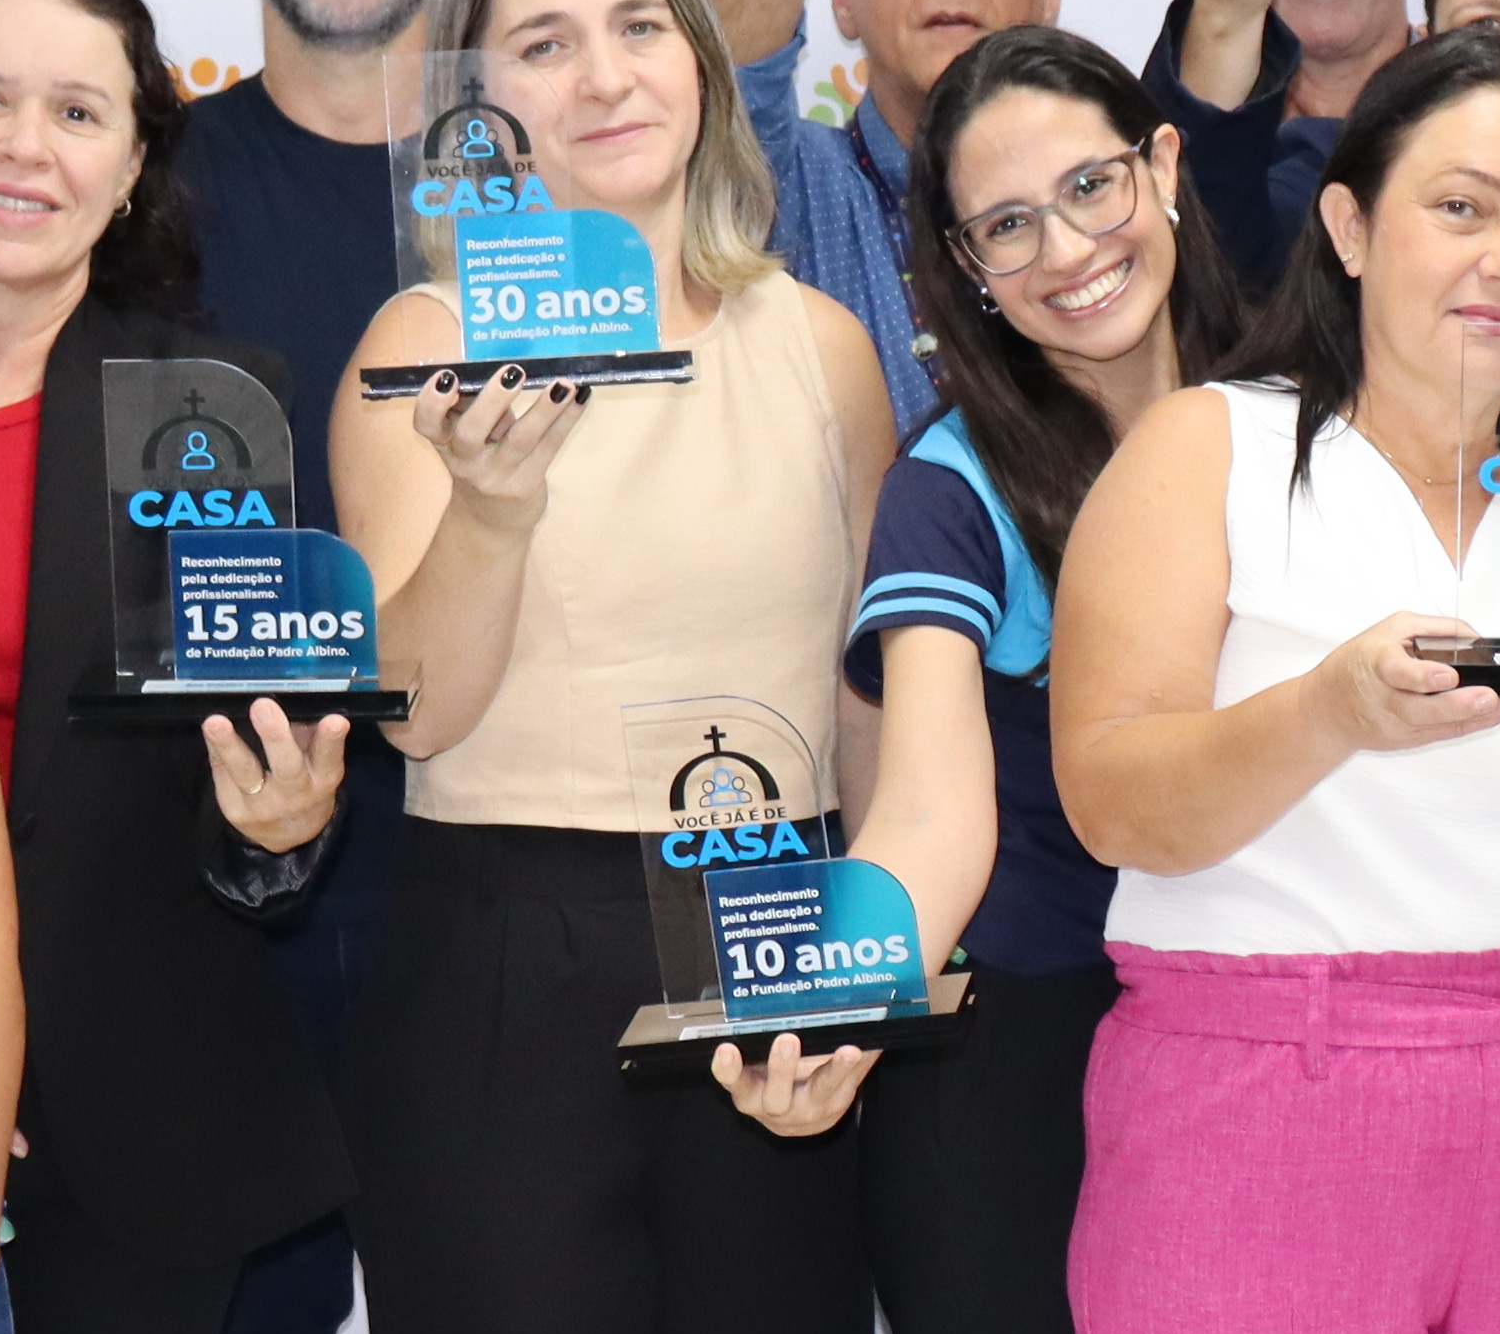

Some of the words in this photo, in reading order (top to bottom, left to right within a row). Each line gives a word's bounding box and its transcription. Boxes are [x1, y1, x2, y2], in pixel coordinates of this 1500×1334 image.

[411, 175, 554, 217] CASA
[469, 284, 527, 324] 30
[536, 284, 646, 319] anos
[128, 490, 276, 528] CASA
[181, 556, 282, 568] Reconhecimento
[181, 573, 208, 587] pela
[210, 572, 272, 587] dedicação
[275, 575, 283, 584] e
[182, 589, 279, 602] profissionalismo.
[185, 604, 240, 641] 15
[251, 609, 365, 641] anos
[186, 647, 201, 658] de
[204, 646, 265, 660] Fundação
[268, 646, 304, 658] Padre
[306, 645, 350, 658] Albino.
[674, 811, 720, 830] VOCÊ
[724, 809, 745, 824] JÁ
[750, 808, 760, 821] É
[765, 806, 787, 819] DE
[661, 821, 810, 869] CASA
[719, 888, 819, 908] Reconhecimento
[720, 912, 747, 927] pela
[749, 906, 811, 922] dedicação
[814, 906, 822, 915] e
[724, 922, 820, 942] profissionalismo.
[727, 939, 785, 980] 10
[795, 935, 909, 971] anos
[733, 986, 749, 998] de
[751, 981, 812, 996] Fundação
[814, 976, 850, 990] Padre
[852, 971, 897, 986] Albino.
